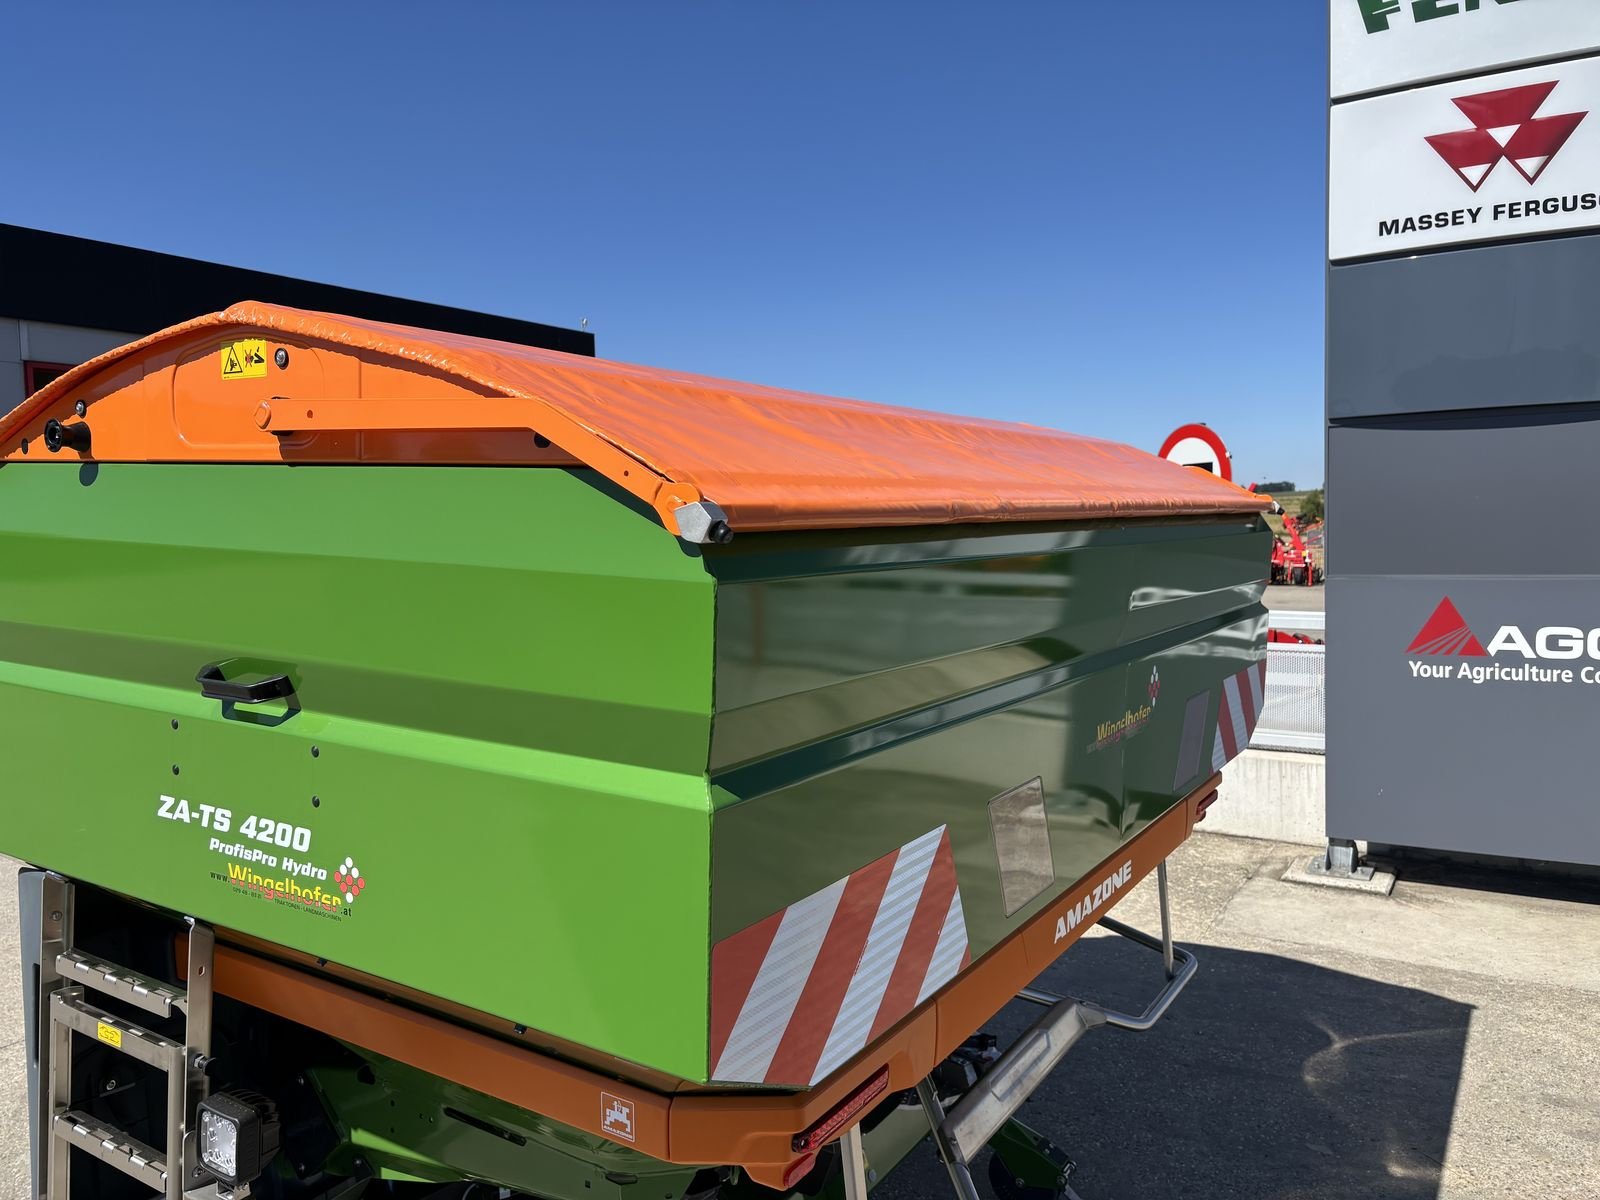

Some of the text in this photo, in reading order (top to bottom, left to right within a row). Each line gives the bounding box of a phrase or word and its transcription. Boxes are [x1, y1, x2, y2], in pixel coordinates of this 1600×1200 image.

[1378, 193, 1600, 237] MASSEY FERGUS
[1408, 660, 1453, 679] Your
[1457, 662, 1573, 684] Agriculture
[157, 794, 311, 853] ZA-TS 4200
[209, 837, 327, 881] ProfisPro Hydro
[1053, 859, 1132, 945] AMAZONE
